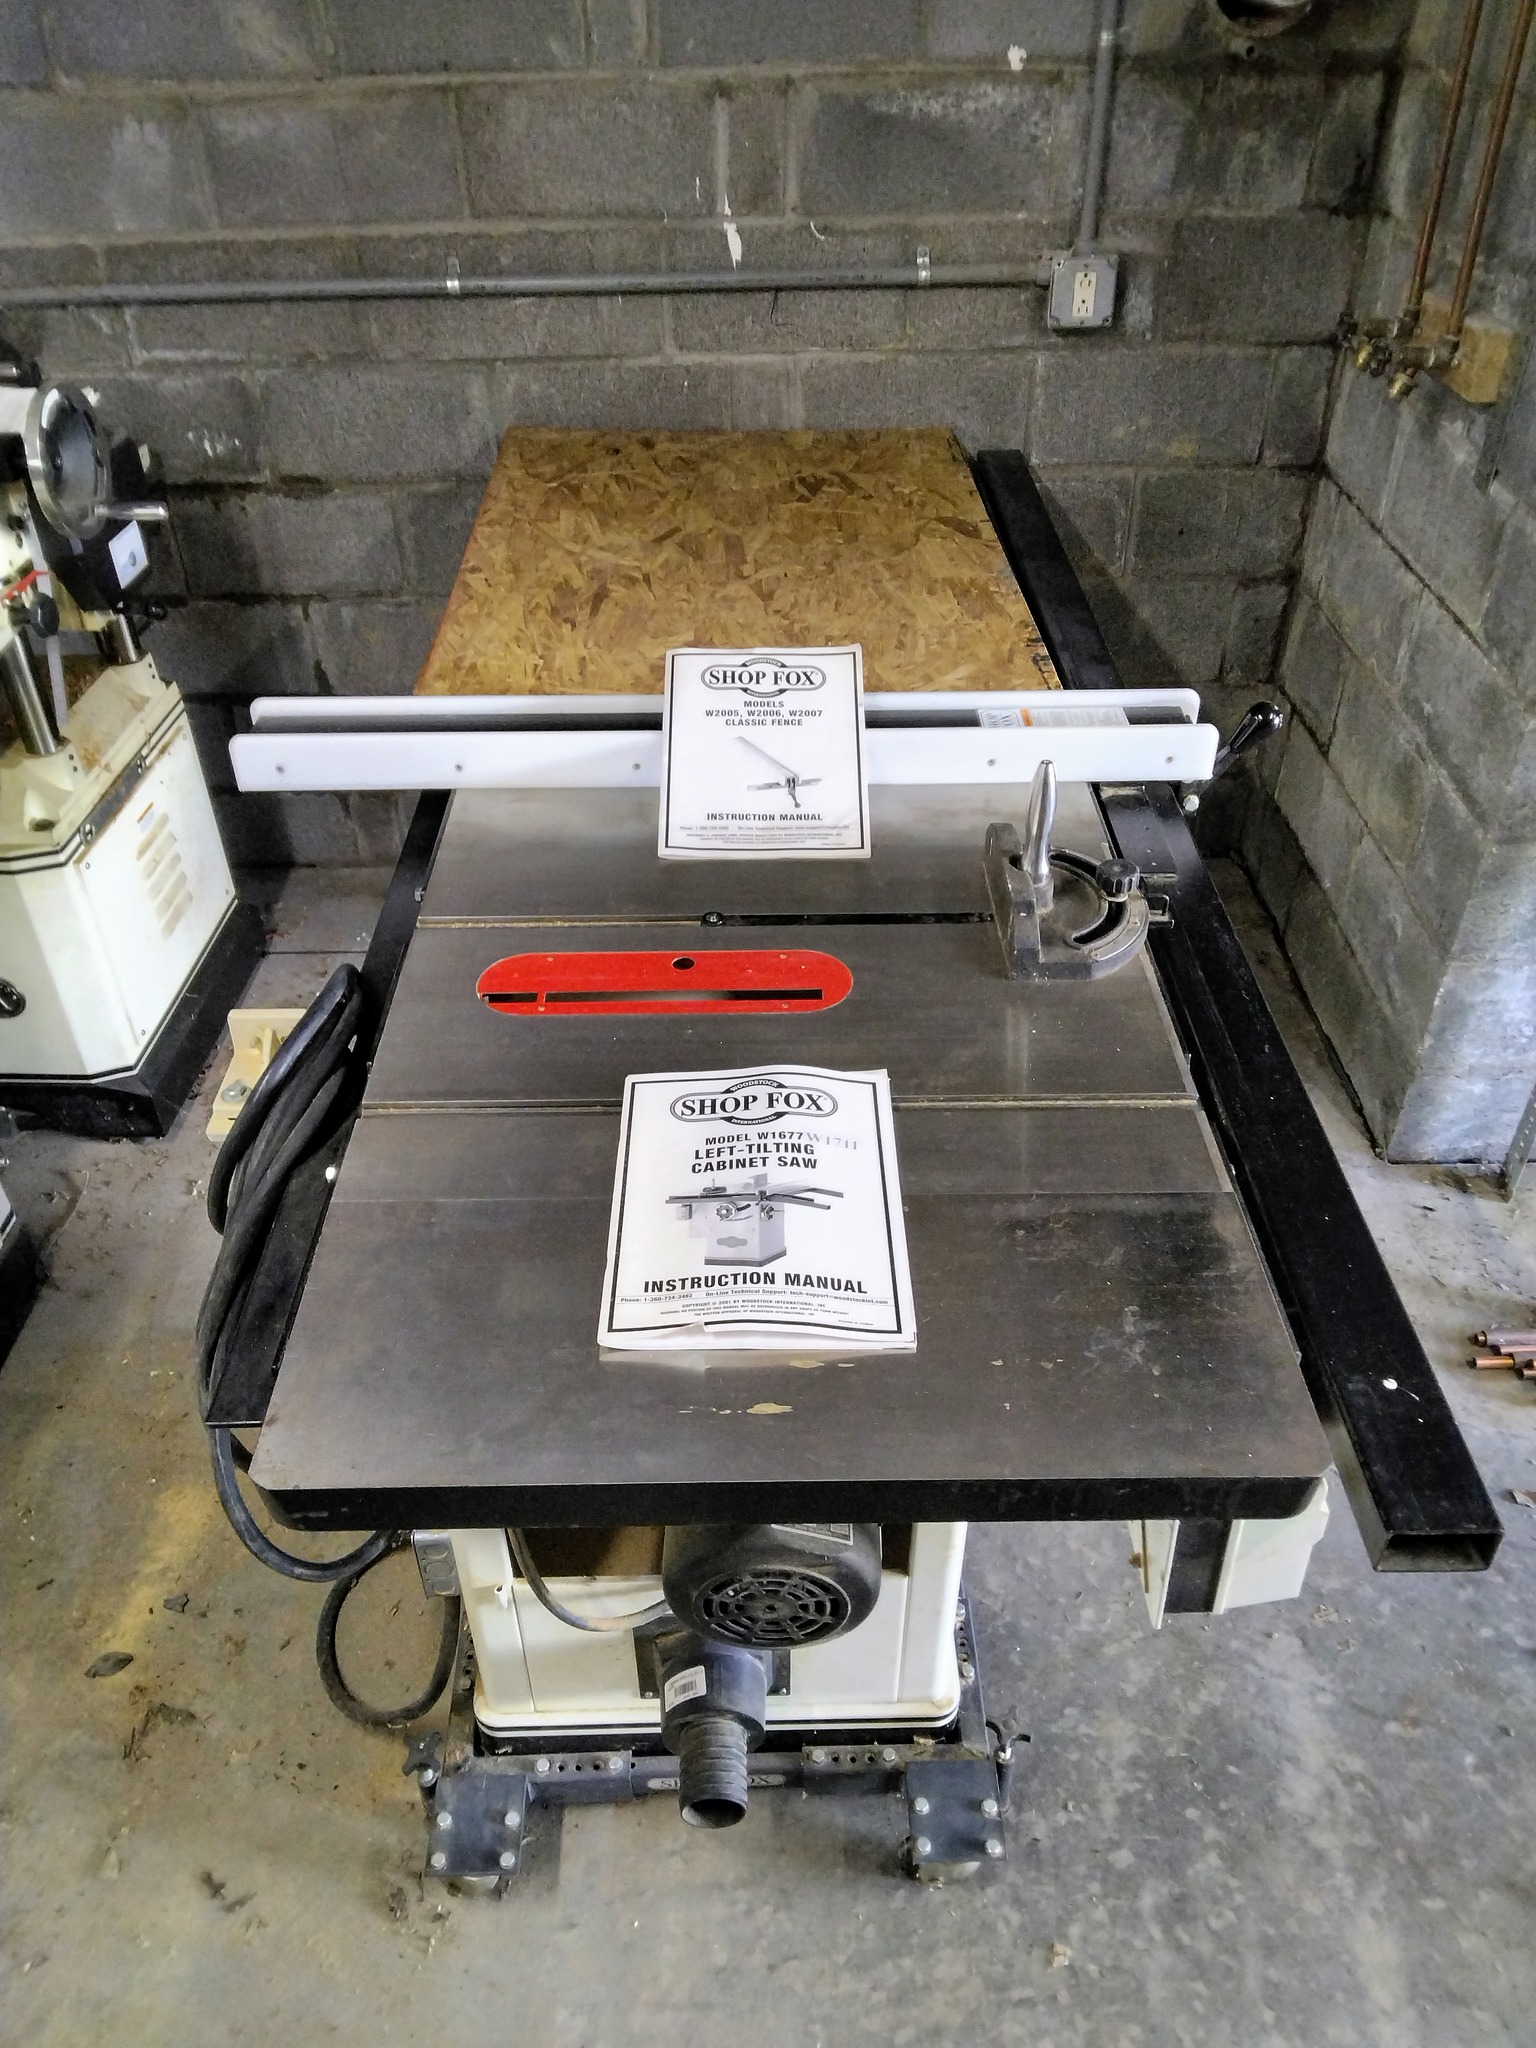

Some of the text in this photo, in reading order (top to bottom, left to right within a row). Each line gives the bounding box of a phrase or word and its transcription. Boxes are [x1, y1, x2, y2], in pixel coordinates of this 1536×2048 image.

[708, 669, 817, 686] SHOP FOX
[743, 700, 785, 708] MODELS
[705, 709, 823, 718] W2005, W2006, W2007
[725, 718, 803, 726] CLASSIC FENCE
[706, 812, 823, 822] INSTRUCTION MANUAL
[730, 1079, 779, 1091] WOODSTOCK
[680, 1091, 825, 1117] SHOP FOX
[705, 1133, 751, 1146] MODEL
[757, 1131, 803, 1140] W1677
[694, 1142, 815, 1160] LEFT-TILTING
[691, 1156, 817, 1174] CABINET SAW
[643, 1271, 868, 1294] INSTRUCTION MANUAL
